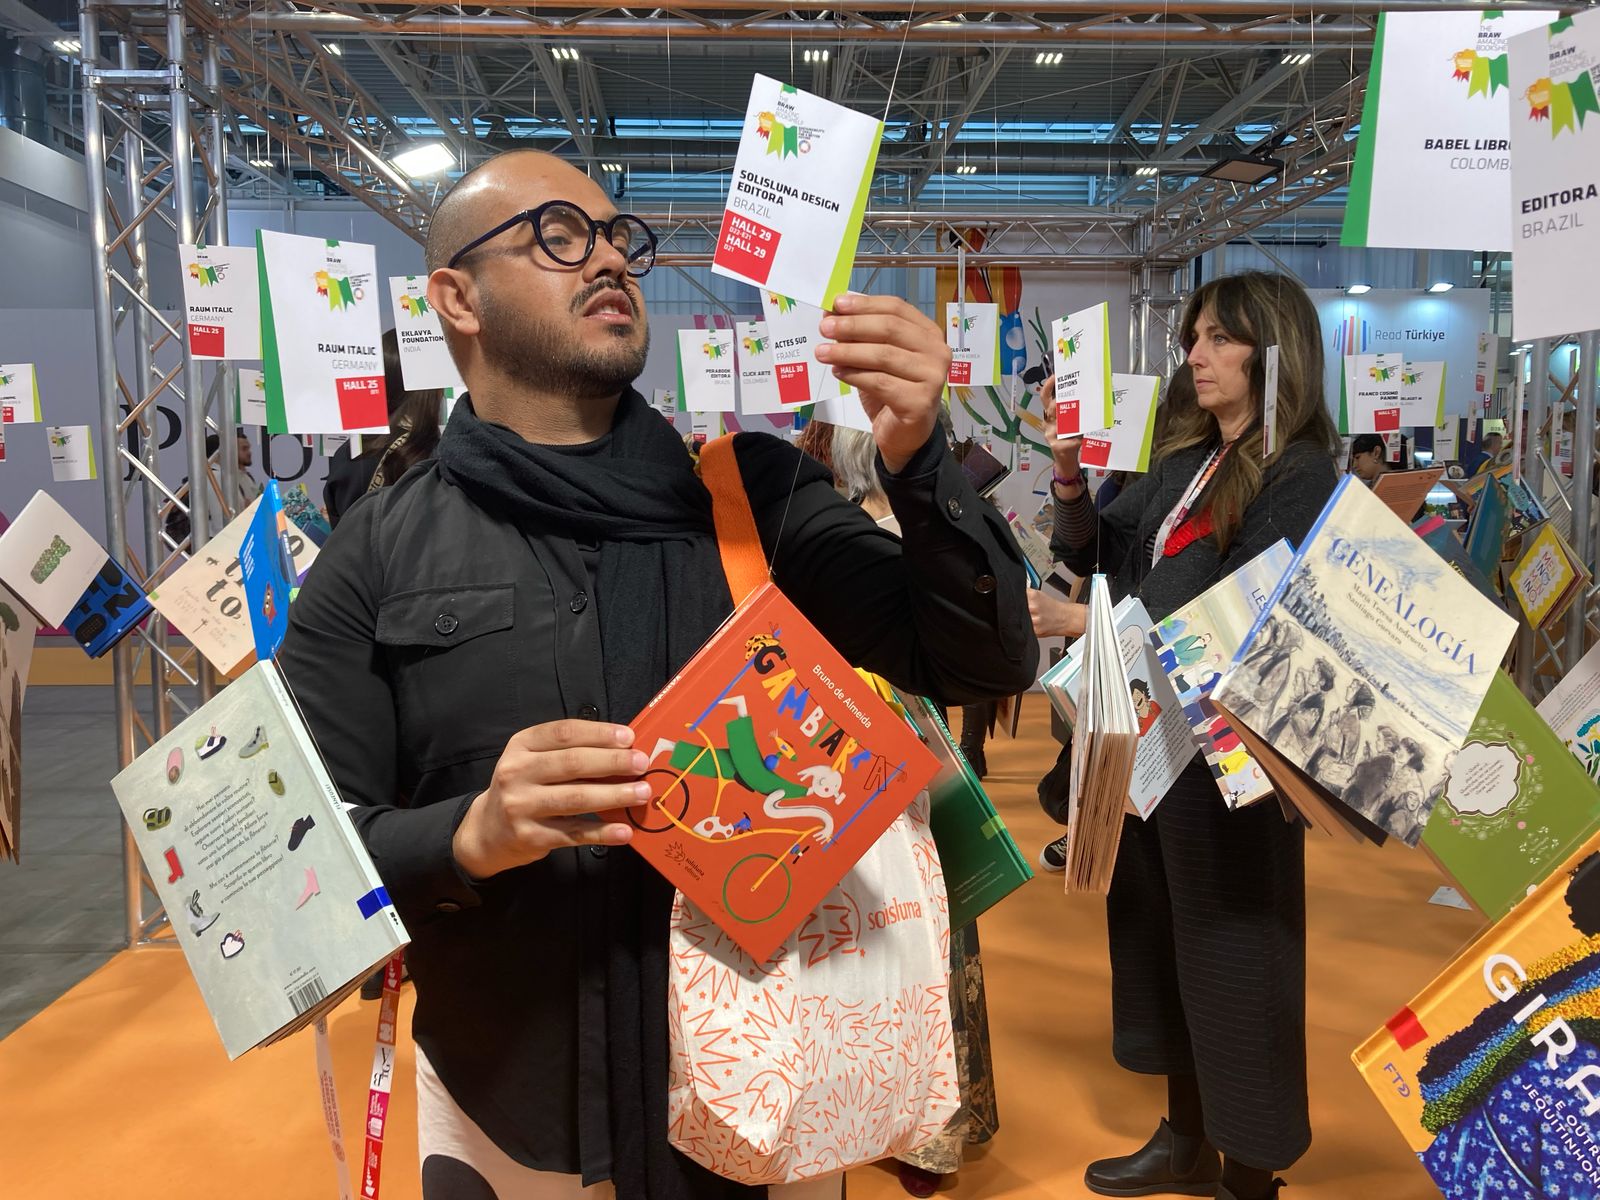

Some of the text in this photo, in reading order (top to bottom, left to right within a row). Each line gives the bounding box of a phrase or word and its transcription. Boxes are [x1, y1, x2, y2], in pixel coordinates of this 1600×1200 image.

[1549, 46, 1576, 60] BRAW
[777, 101, 795, 111] BRAW
[1424, 139, 1471, 150] BABEL
[1450, 157, 1512, 170] COLOMB
[737, 181, 784, 206] EDITORA
[740, 170, 840, 213] SOLISLUNA DESIGN
[1521, 184, 1598, 214] EDITORA
[733, 196, 771, 219] BRAZIL
[732, 216, 772, 242] HALL 29
[1522, 212, 1583, 239] BRAZIL
[726, 234, 767, 259] HALL 29
[193, 326, 210, 334] HALL
[1375, 329, 1446, 342] Read Türkiye
[775, 336, 807, 349] ACTES SUD
[318, 343, 376, 356] RAUM ITALIC
[776, 349, 801, 360] FRANCE
[332, 359, 378, 371] GERMANY
[780, 366, 795, 374] HALL
[1057, 371, 1080, 383] KILOWATT
[343, 380, 366, 390] HALL
[1058, 379, 1078, 390] EDITIONS
[1058, 389, 1075, 398] FRANCE
[1059, 403, 1071, 411] HALL
[1086, 439, 1100, 447] HALL
[1332, 537, 1477, 675] GENEALOGÍA
[1344, 592, 1405, 645] Santiago Guevara
[1350, 582, 1430, 653] María Teresa Andruetto
[812, 664, 872, 728] Bruno de Almeida
[754, 646, 887, 791] GAMBIARRA
[1554, 1099, 1566, 1113] E
